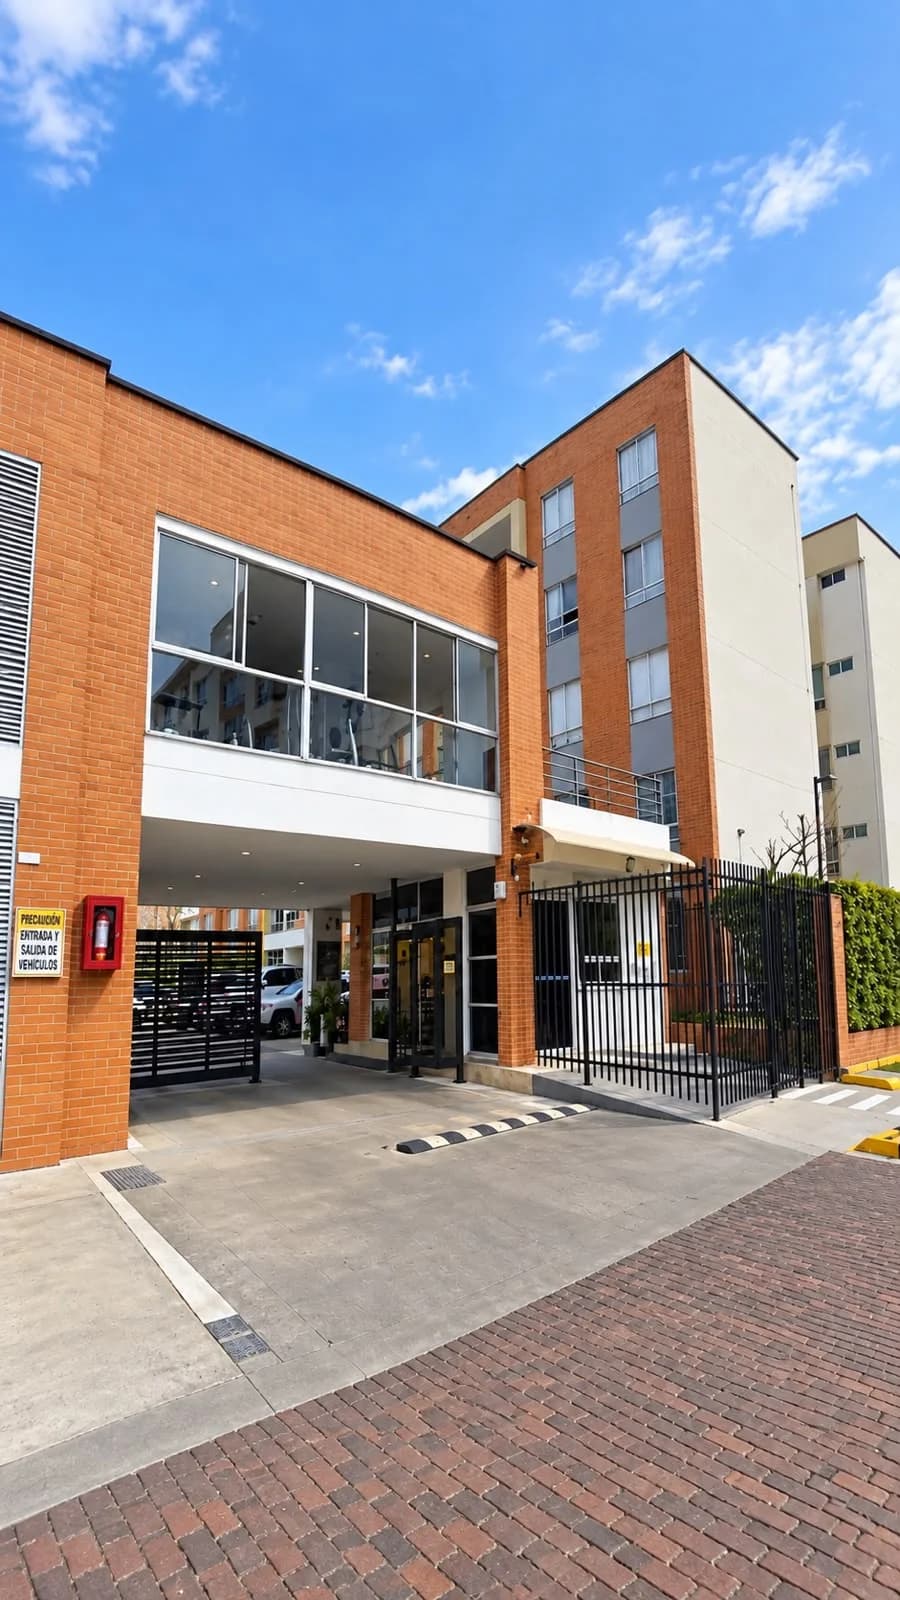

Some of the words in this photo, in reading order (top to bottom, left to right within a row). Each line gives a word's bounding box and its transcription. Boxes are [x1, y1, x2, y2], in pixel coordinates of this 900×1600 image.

[20, 912, 61, 925] PRECAUCIÓN
[20, 930, 52, 941] ENTRADA
[55, 930, 59, 941] Y
[21, 945, 46, 955] SALIDA
[48, 945, 57, 955] DE
[18, 959, 58, 970] VEHÍCULOS
